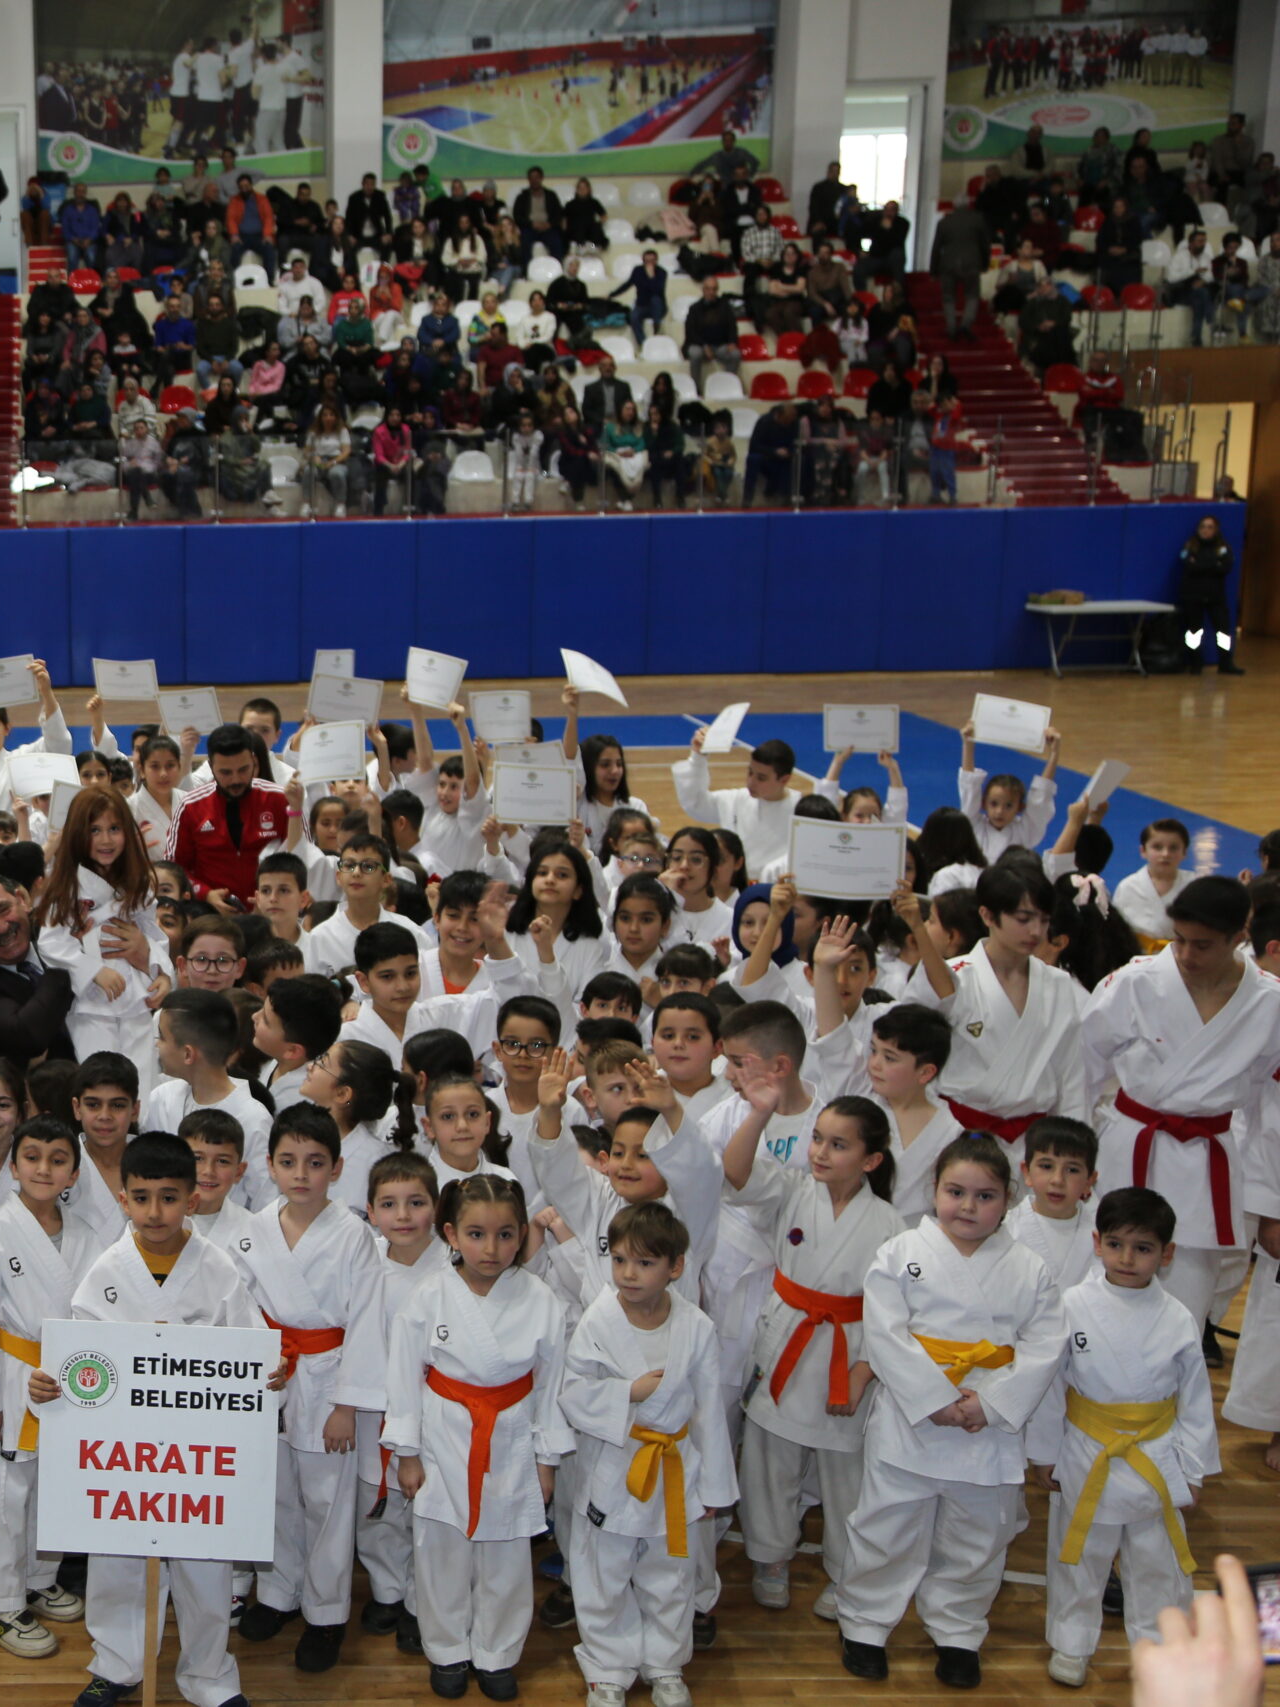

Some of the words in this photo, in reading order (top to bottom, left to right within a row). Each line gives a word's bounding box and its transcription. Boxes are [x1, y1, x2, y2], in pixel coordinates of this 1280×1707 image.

[132, 1352, 264, 1381] ETİMESGUT
[130, 1387, 264, 1412] BELEDİYESİ
[78, 1438, 237, 1477] KARATE
[86, 1488, 225, 1526] TAKIMI
